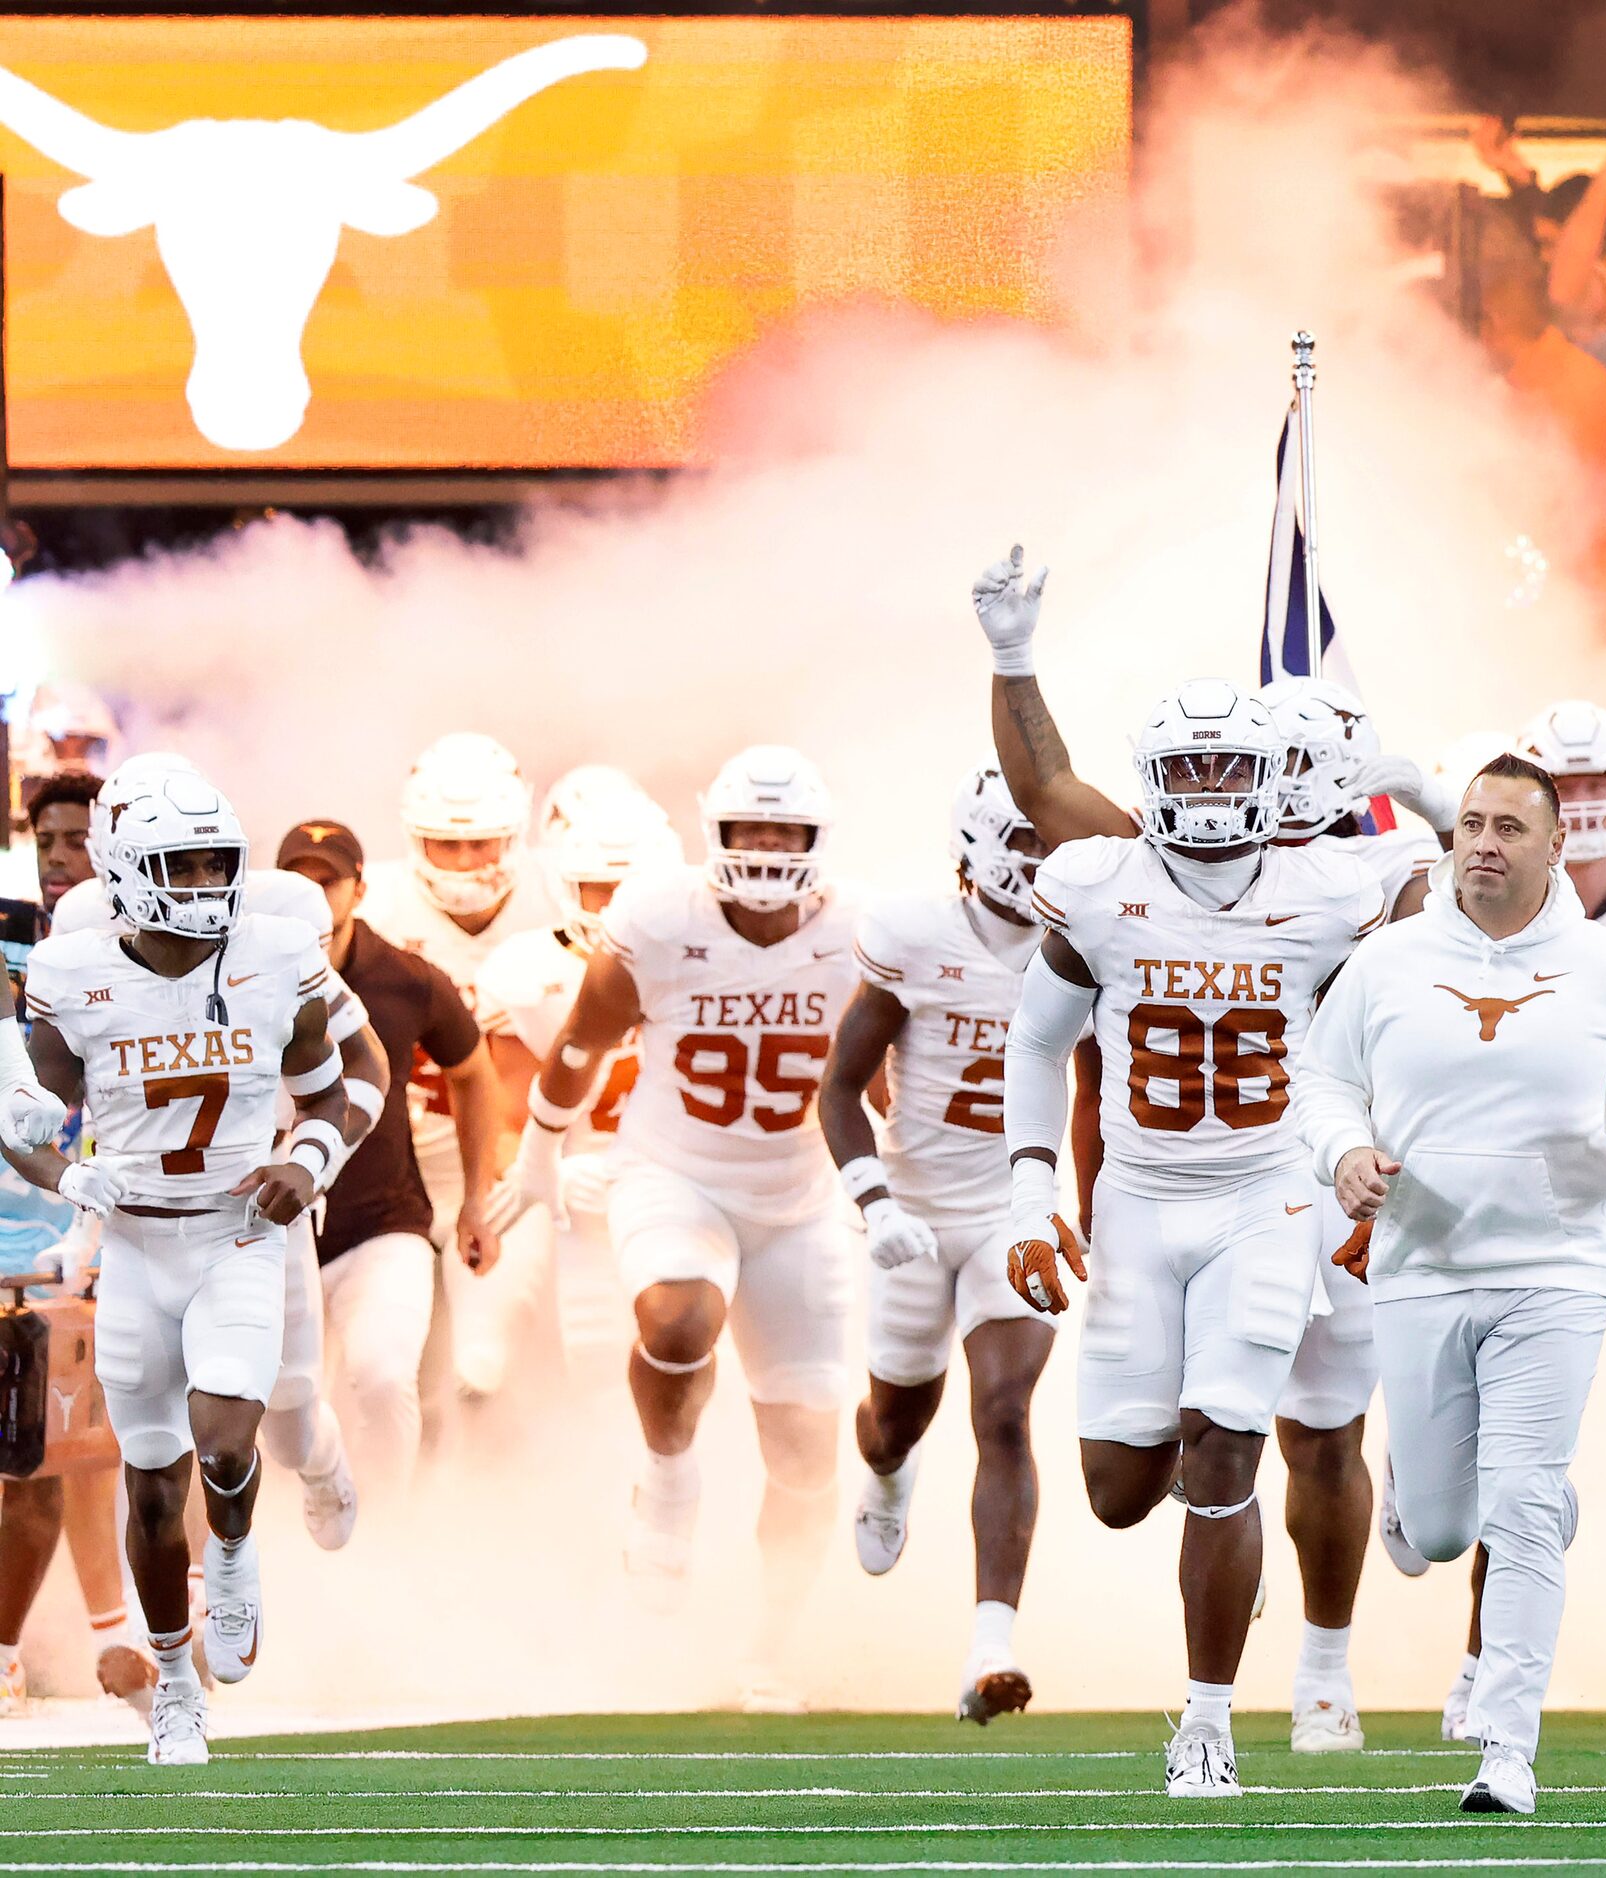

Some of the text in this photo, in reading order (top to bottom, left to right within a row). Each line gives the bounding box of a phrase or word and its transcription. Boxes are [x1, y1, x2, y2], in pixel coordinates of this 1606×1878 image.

[1192, 730, 1222, 740] HORNS
[1134, 959, 1283, 1002] TEXAS
[691, 991, 827, 1027] TEXAS
[110, 1028, 254, 1077] TEXAS
[1127, 1003, 1290, 1132] 88
[674, 1032, 830, 1133] 95
[143, 1072, 230, 1175] 7
